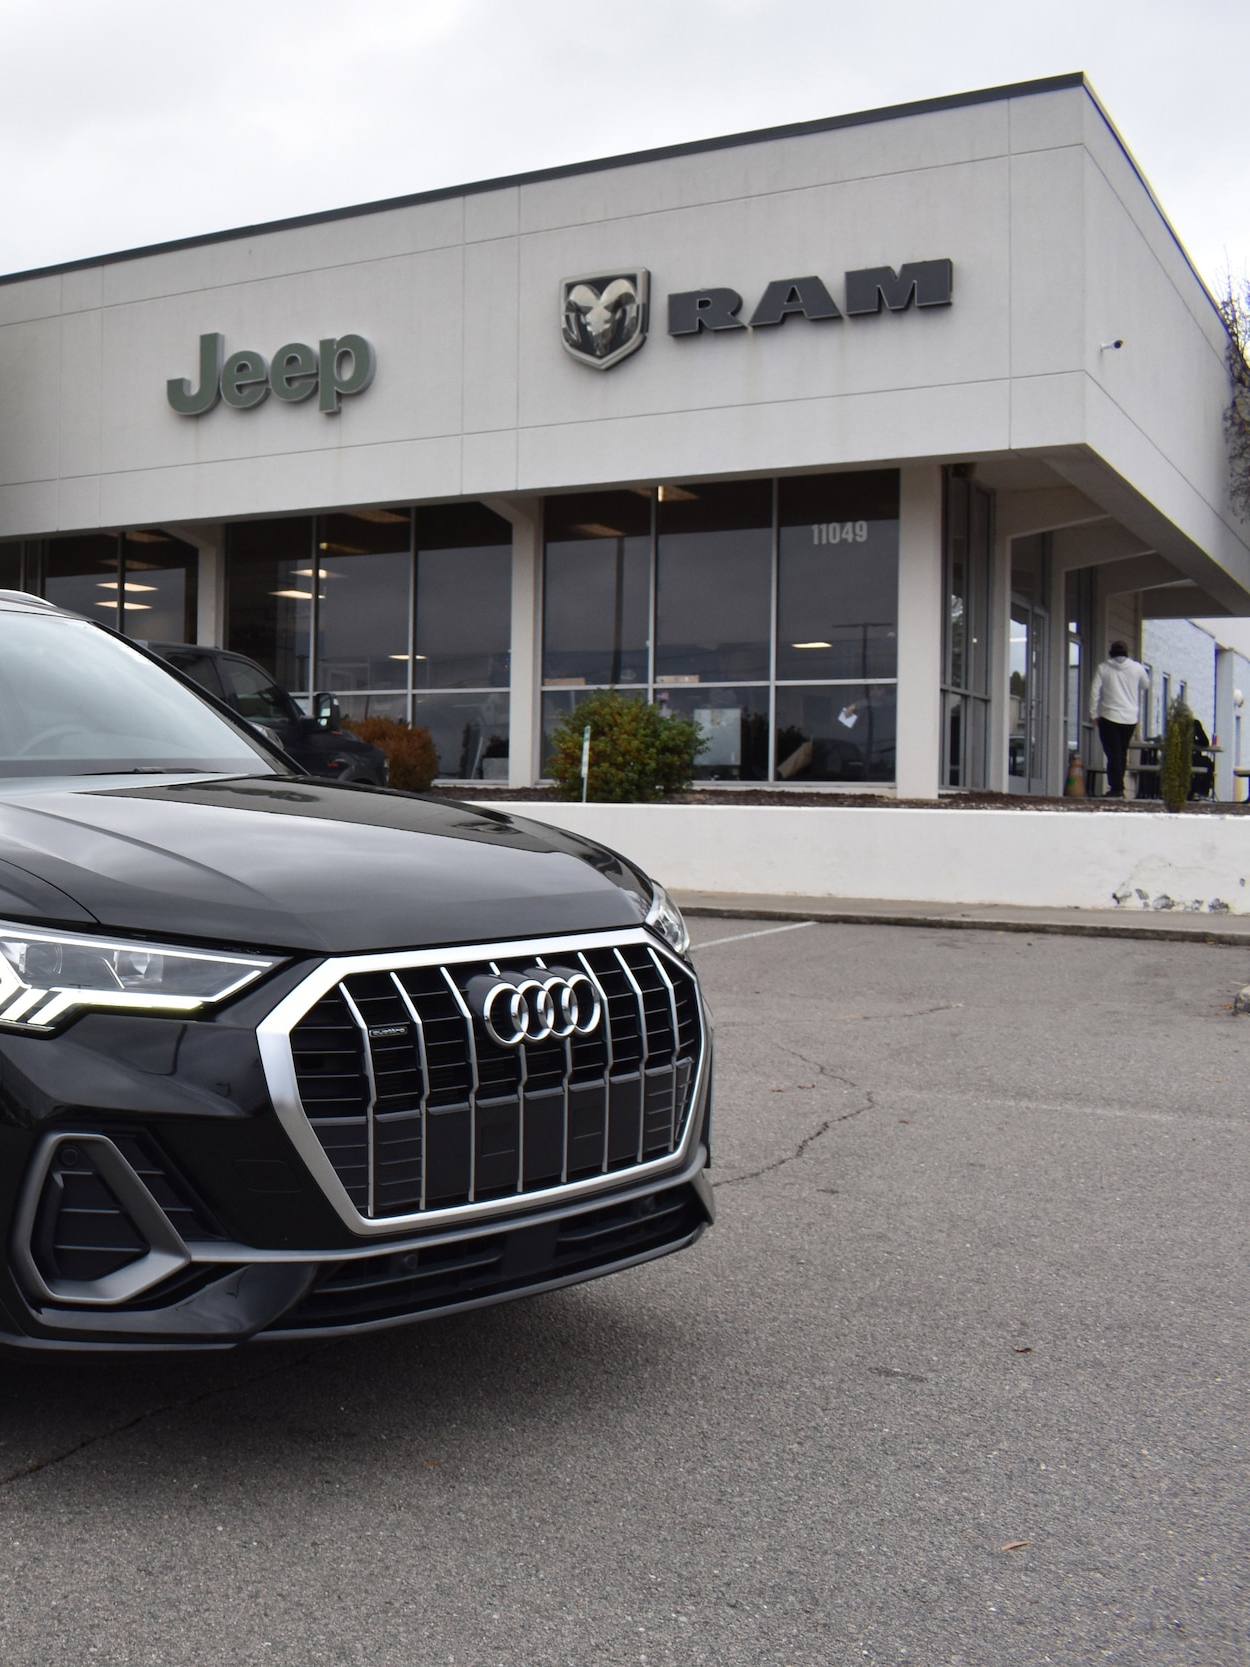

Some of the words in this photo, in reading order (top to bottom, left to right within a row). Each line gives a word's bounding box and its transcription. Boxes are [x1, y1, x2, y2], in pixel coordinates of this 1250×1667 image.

[667, 258, 953, 337] RAM
[166, 332, 376, 416] Jeep
[811, 520, 868, 545] 11049
